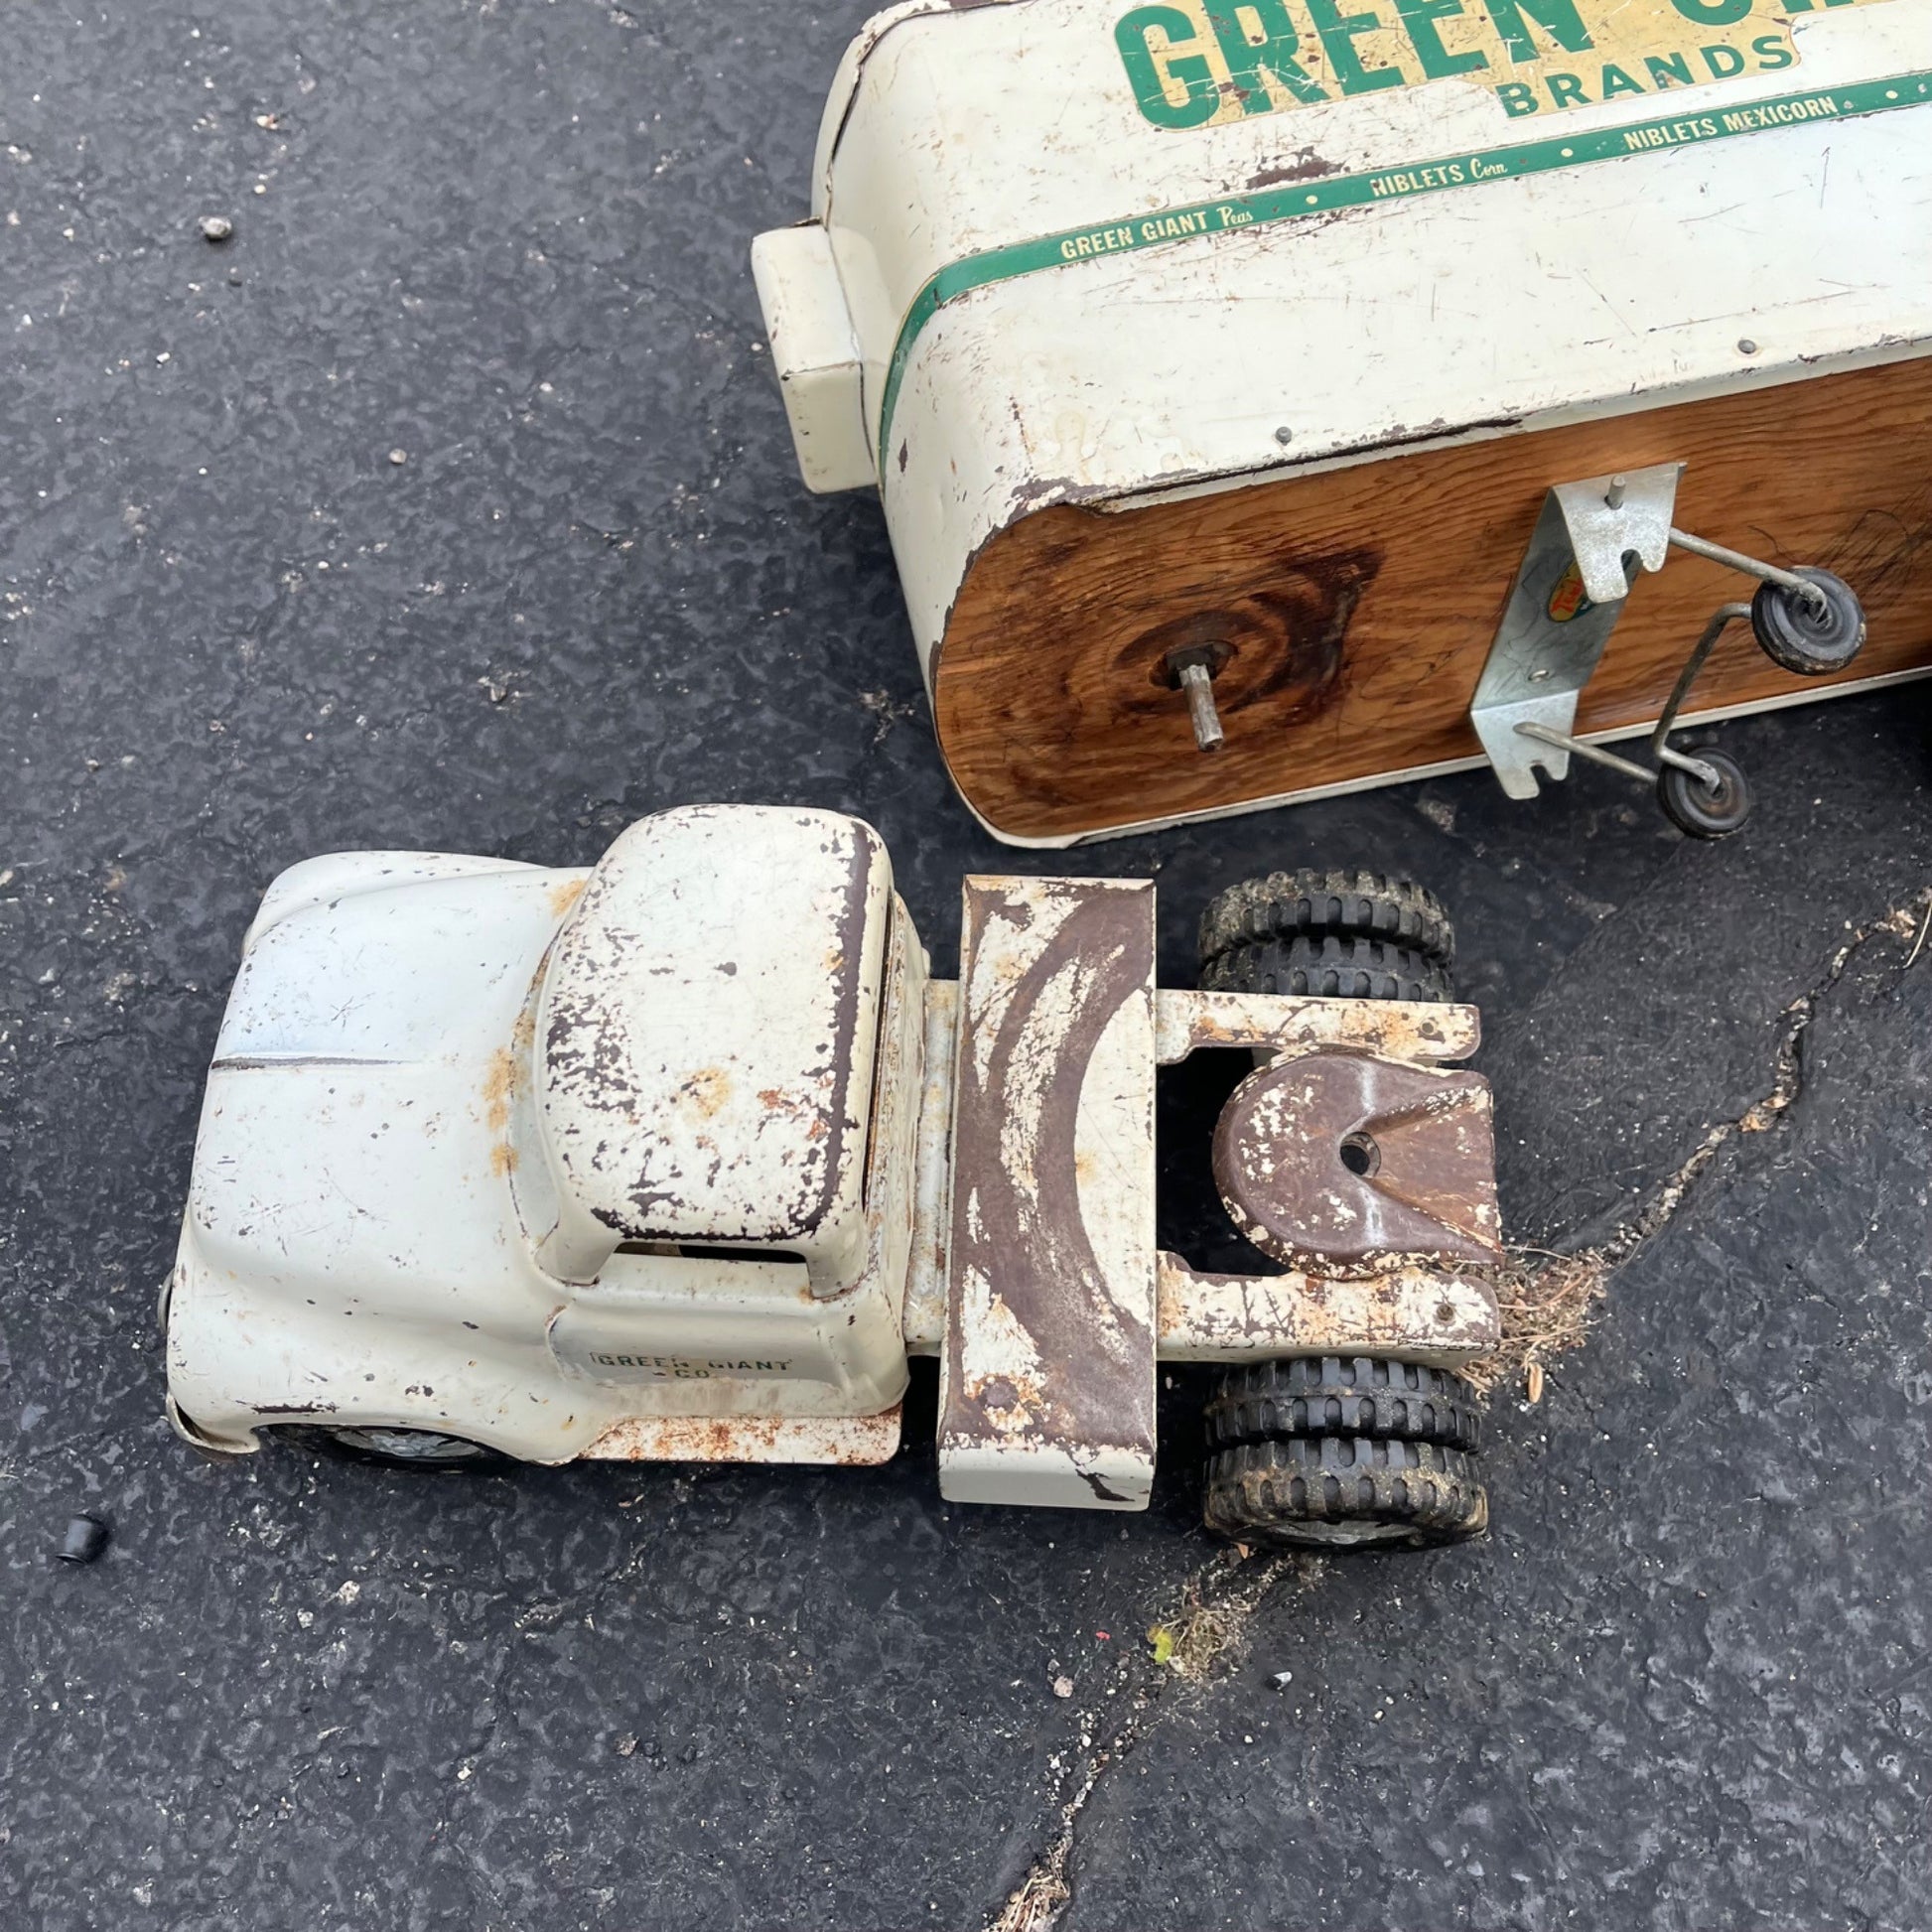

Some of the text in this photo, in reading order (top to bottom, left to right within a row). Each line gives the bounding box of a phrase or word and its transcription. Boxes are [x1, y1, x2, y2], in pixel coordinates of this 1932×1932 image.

[1114, 0, 1594, 130] GREEN
[1495, 36, 1793, 118] BRANDS
[1623, 96, 1839, 150] NIBLETS MEXICORN
[1370, 158, 1508, 197] NIBLETS Corn
[1060, 206, 1254, 258] GREEN GIANT Peas
